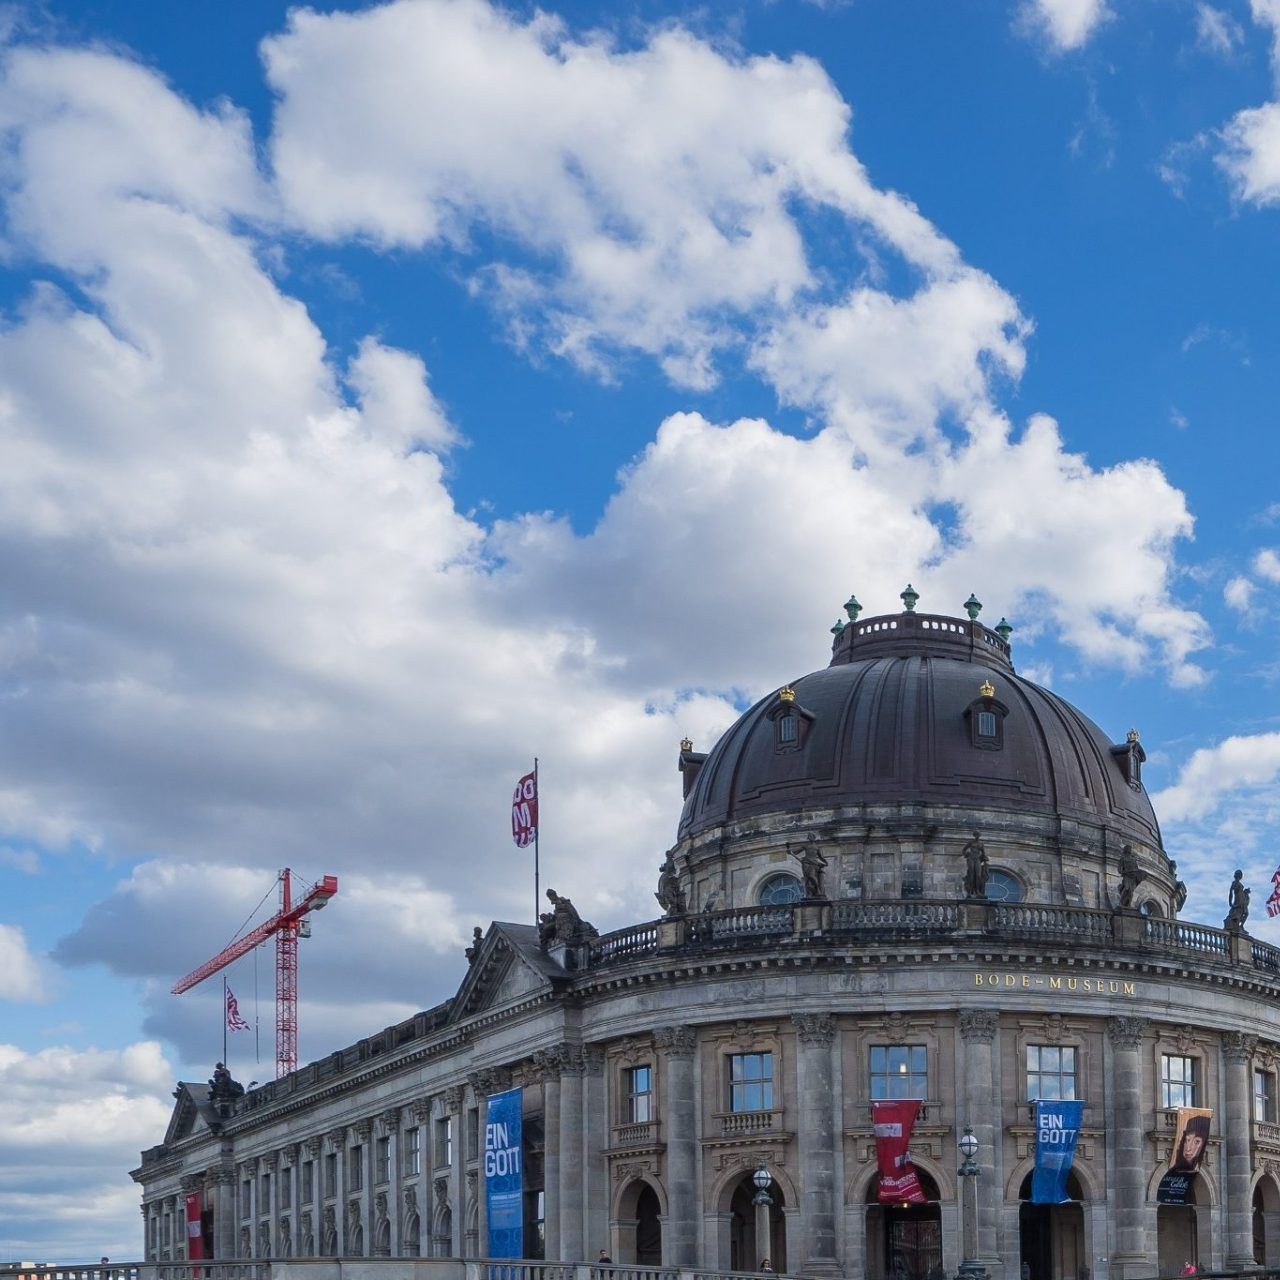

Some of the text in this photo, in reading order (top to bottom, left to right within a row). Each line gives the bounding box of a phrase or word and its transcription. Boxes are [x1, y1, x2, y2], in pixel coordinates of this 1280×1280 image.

[975, 973, 1136, 995] BODE-MUSEUM
[1039, 1114, 1063, 1130] EIN
[485, 1122, 509, 1150] EIN
[1038, 1128, 1077, 1144] GOTT
[484, 1146, 520, 1178] GOTT
